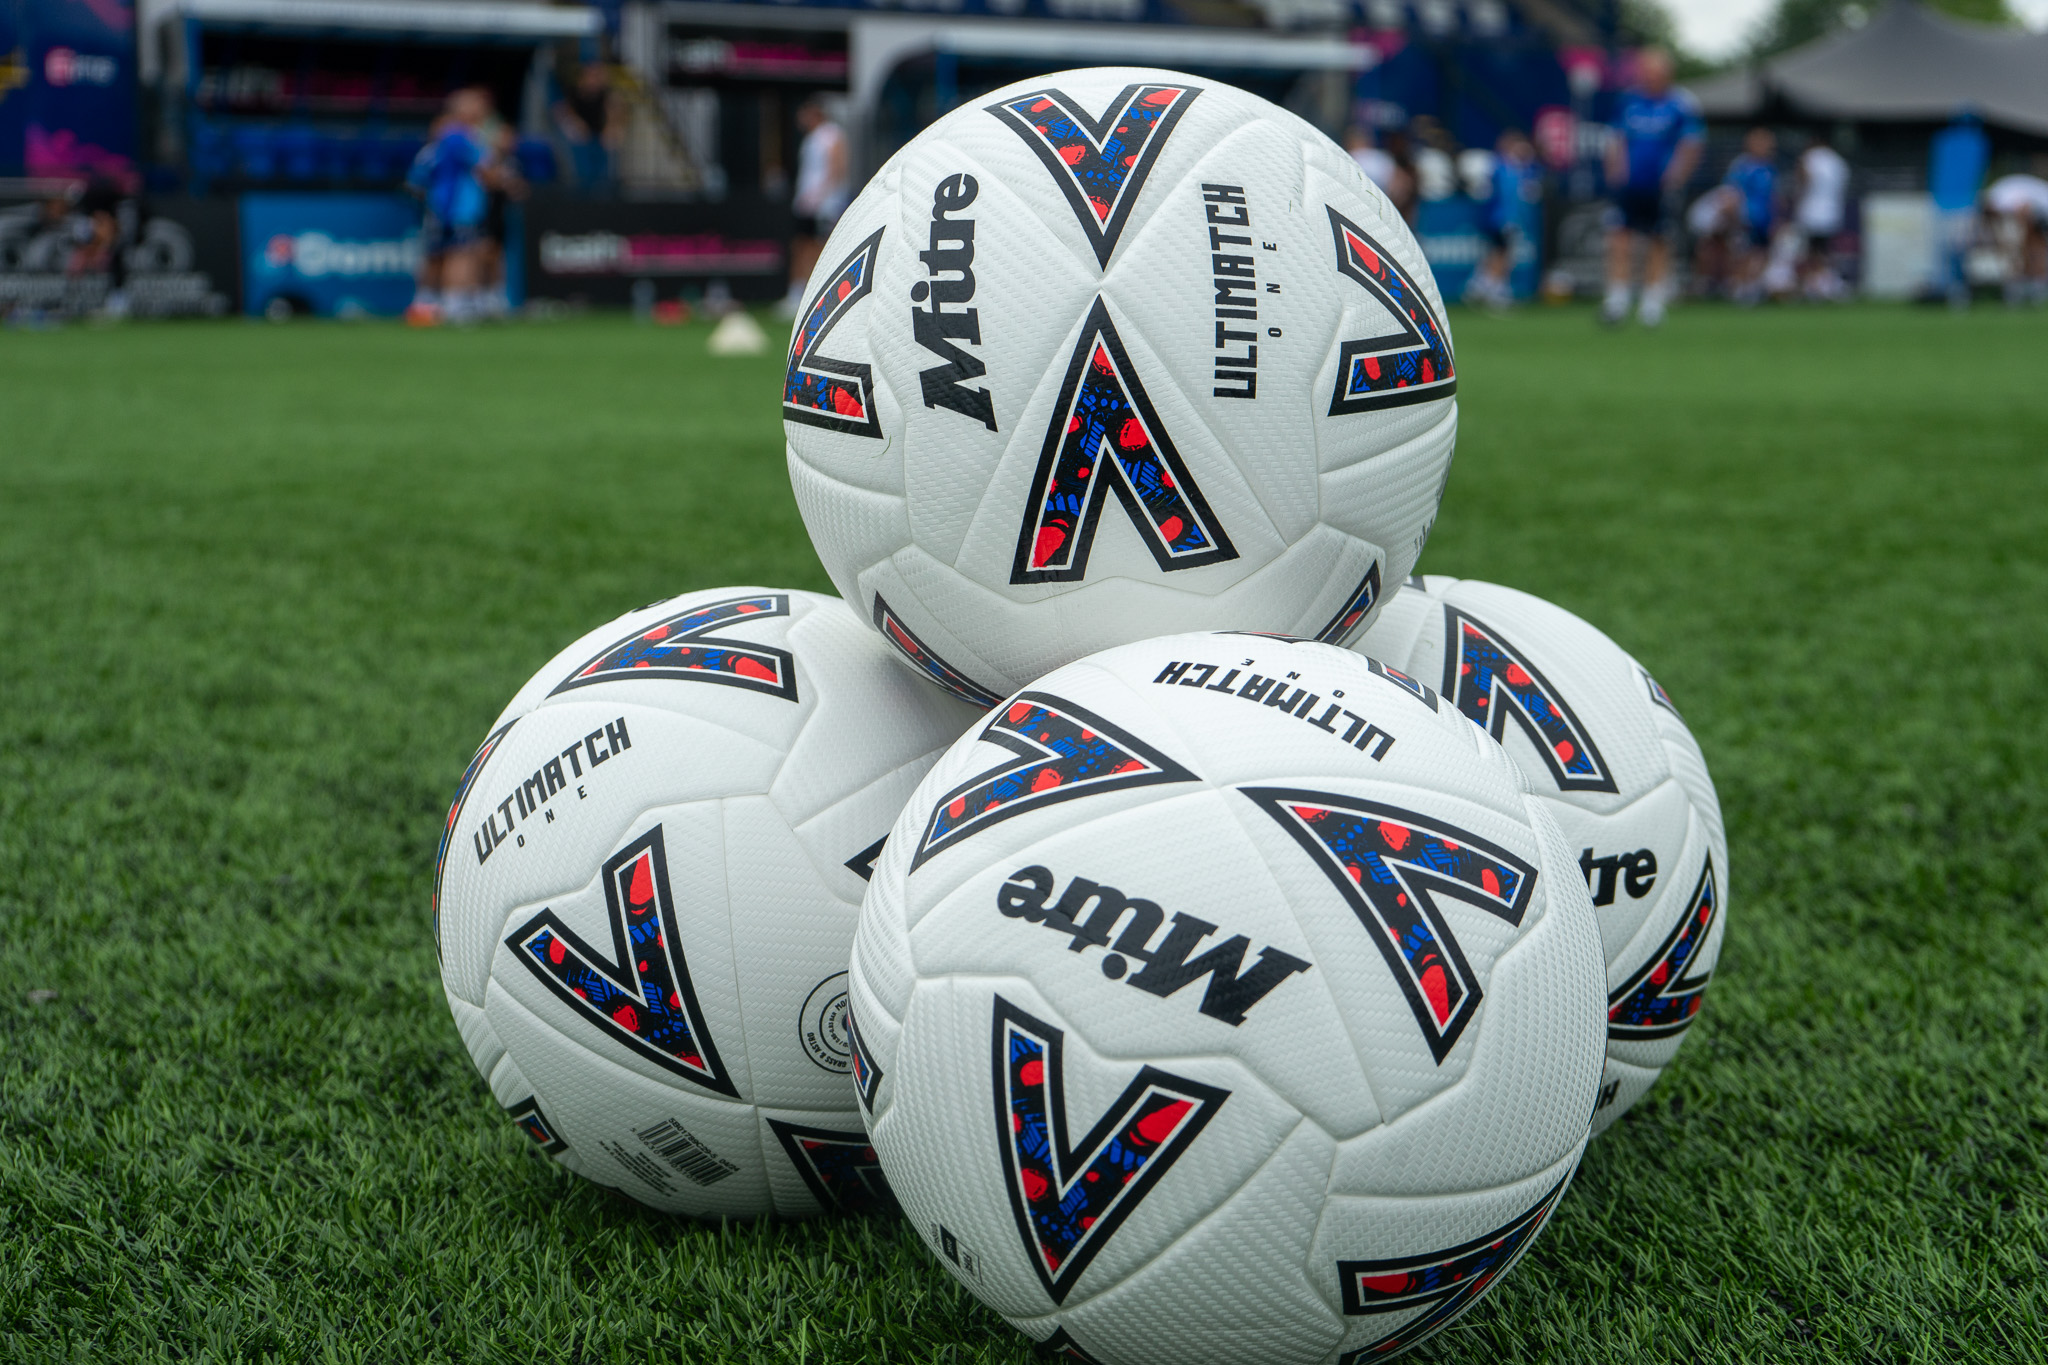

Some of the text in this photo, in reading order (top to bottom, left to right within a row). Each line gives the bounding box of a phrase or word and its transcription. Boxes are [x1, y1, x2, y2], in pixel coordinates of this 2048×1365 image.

[911, 172, 999, 433] Mitre
[1201, 183, 1258, 400] ULTIMATCH
[1152, 661, 1396, 762] ULTIMATCH
[473, 716, 632, 866] ULTIMATCH
[1579, 847, 1658, 908] tre
[997, 865, 1313, 1028] Mitre
[807, 1032, 822, 1053] ASTRO
[825, 1056, 848, 1068] GRASS
